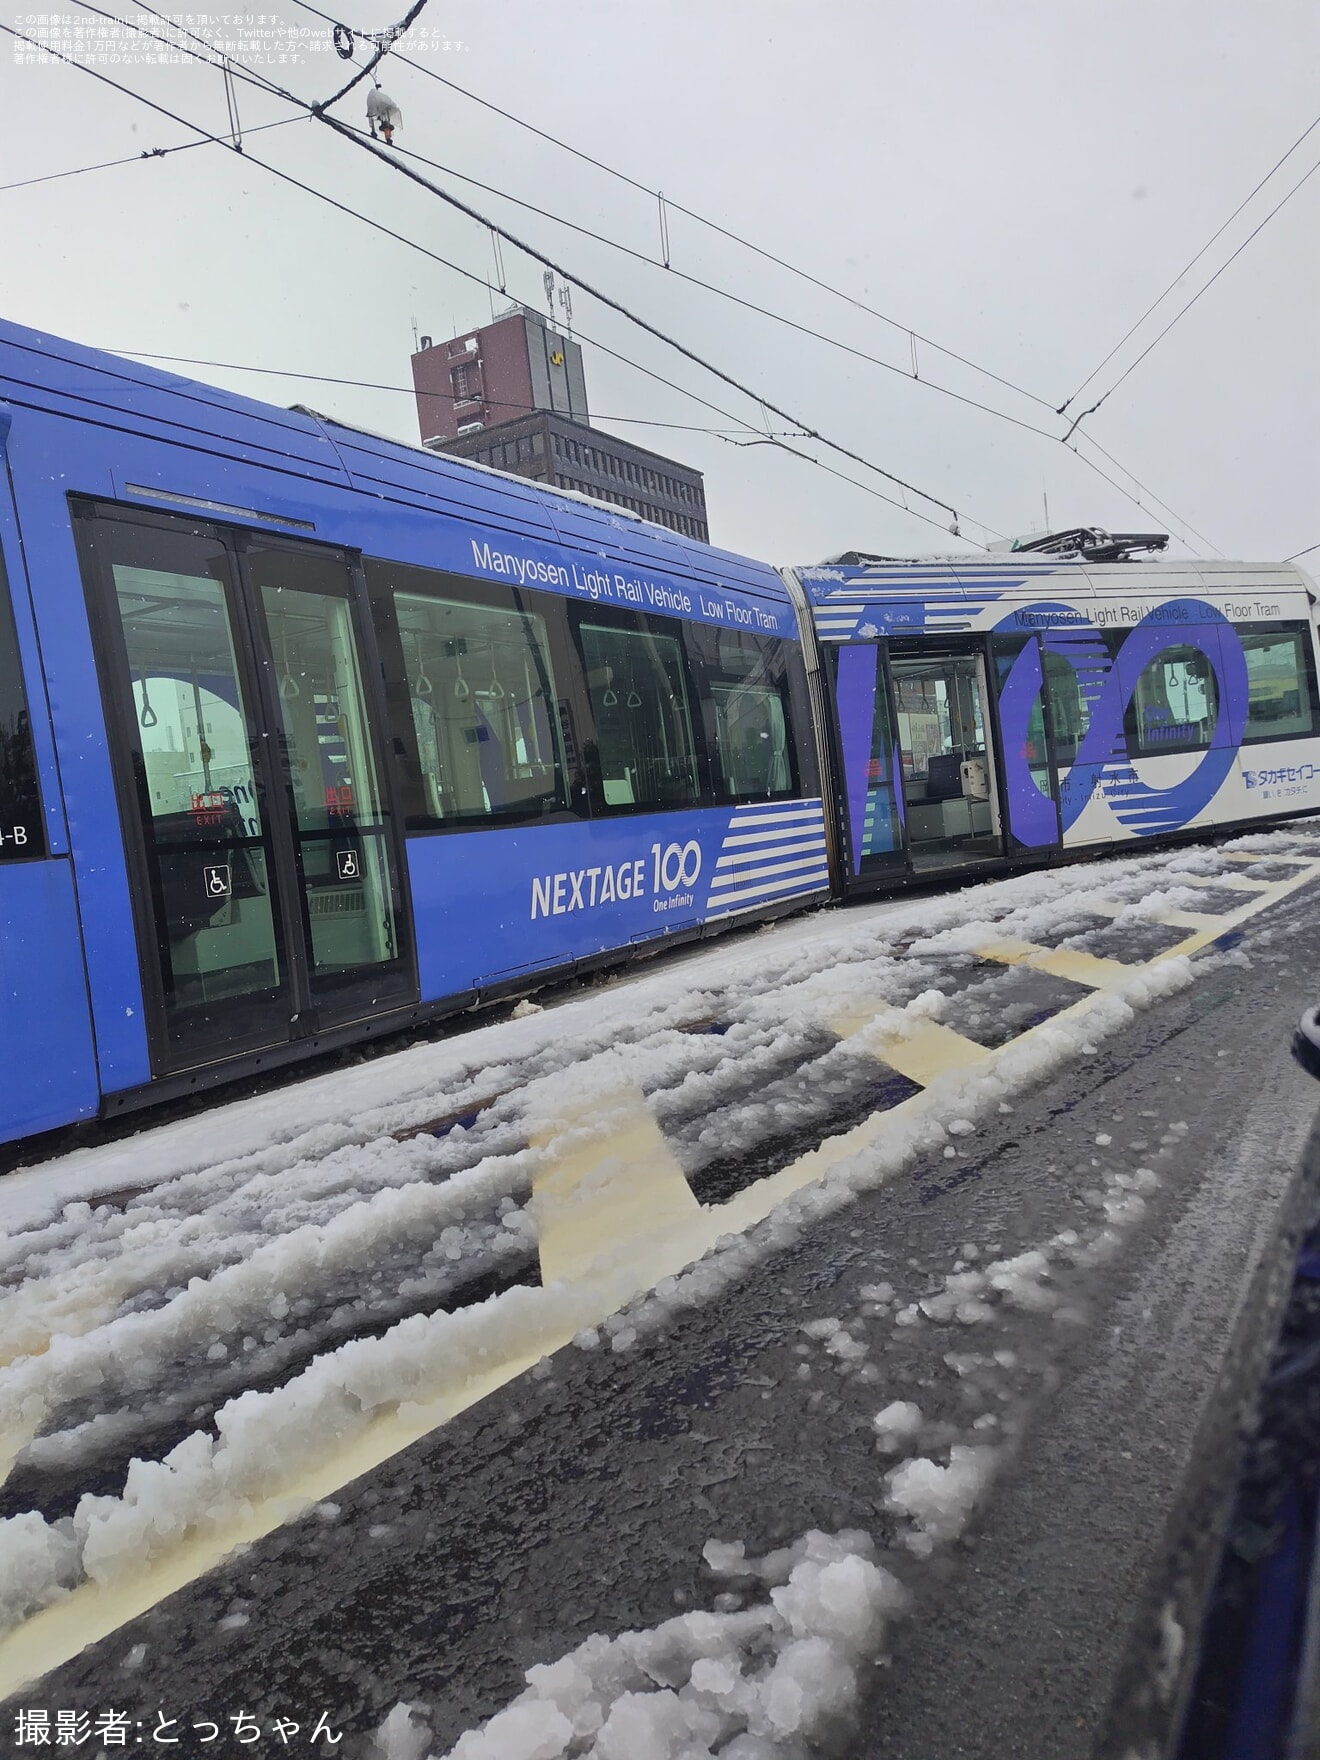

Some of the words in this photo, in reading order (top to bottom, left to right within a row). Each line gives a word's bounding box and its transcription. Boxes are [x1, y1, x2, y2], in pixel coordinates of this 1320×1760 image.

[471, 540, 570, 587] Manyosen
[571, 564, 613, 600] Light
[614, 574, 644, 603] Rail
[644, 581, 692, 613] Vehicle
[699, 594, 724, 619] Low
[725, 601, 752, 625] Floor
[752, 606, 779, 631] Tram
[1014, 610, 1081, 631] Manyosen
[1086, 607, 1118, 627] Light
[1120, 606, 1144, 622] Rail
[1146, 606, 1189, 621] Vehicle
[1198, 607, 1222, 619] Low
[1224, 603, 1252, 617] Floor
[1254, 602, 1281, 616] Tram
[1147, 723, 1194, 743] Infinity
[191, 793, 223, 811] 出口
[325, 786, 353, 804] 出口
[196, 815, 222, 826] EXIT
[530, 859, 645, 920] NEXTAGE
[651, 839, 702, 894] 100
[654, 898, 668, 913] One
[668, 893, 694, 910] Infinity
